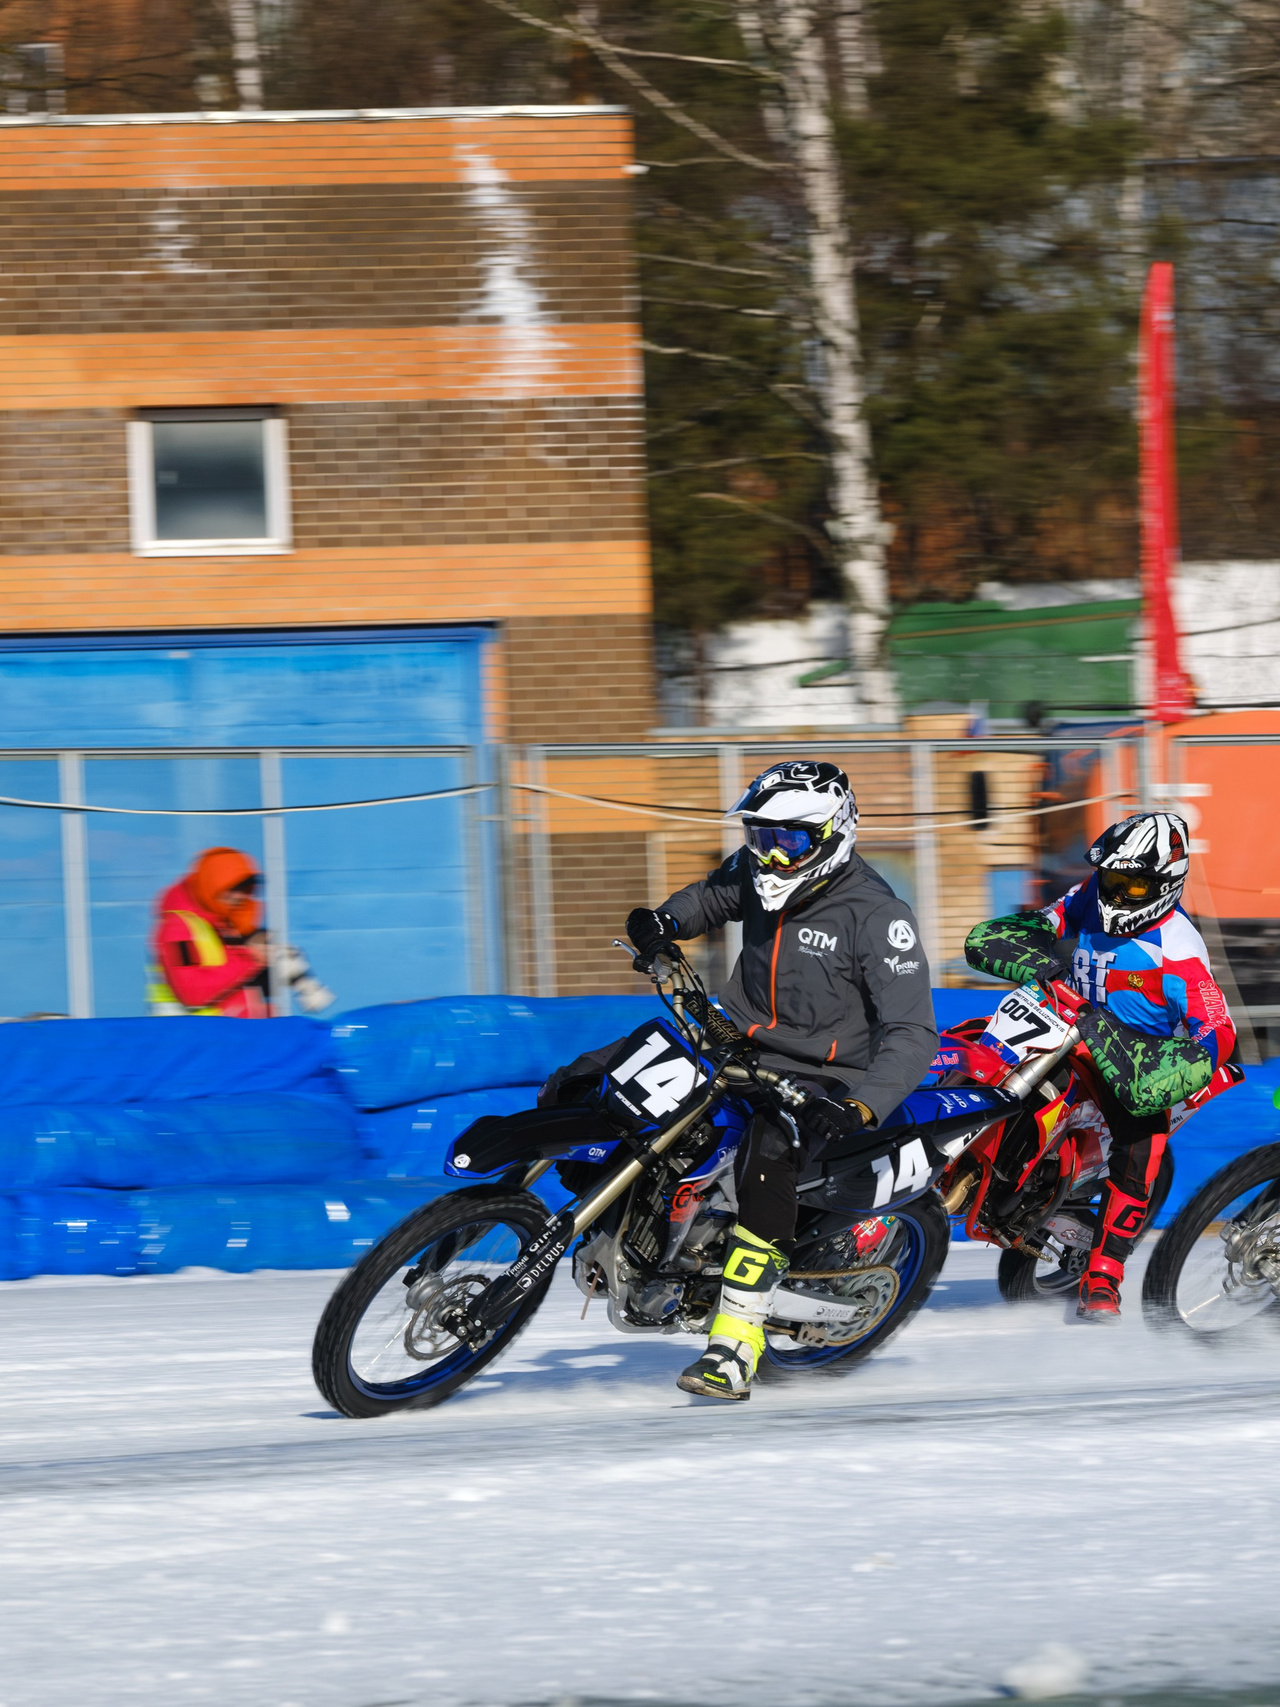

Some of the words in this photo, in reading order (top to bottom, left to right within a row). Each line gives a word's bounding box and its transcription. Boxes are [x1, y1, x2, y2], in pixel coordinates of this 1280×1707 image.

[1111, 859, 1142, 869] Airoh
[798, 928, 838, 952] QTM
[895, 961, 920, 973] PRIME
[993, 959, 1037, 984] LIVE
[1067, 948, 1117, 1004] RT
[1000, 998, 1052, 1047] 007
[943, 1053, 959, 1065] Bull
[611, 1031, 707, 1118] 14
[588, 1147, 607, 1158] QTM
[871, 1137, 933, 1209] 14
[1112, 1204, 1147, 1233] G
[530, 1241, 565, 1278] DELRUS
[723, 1247, 770, 1286] G
